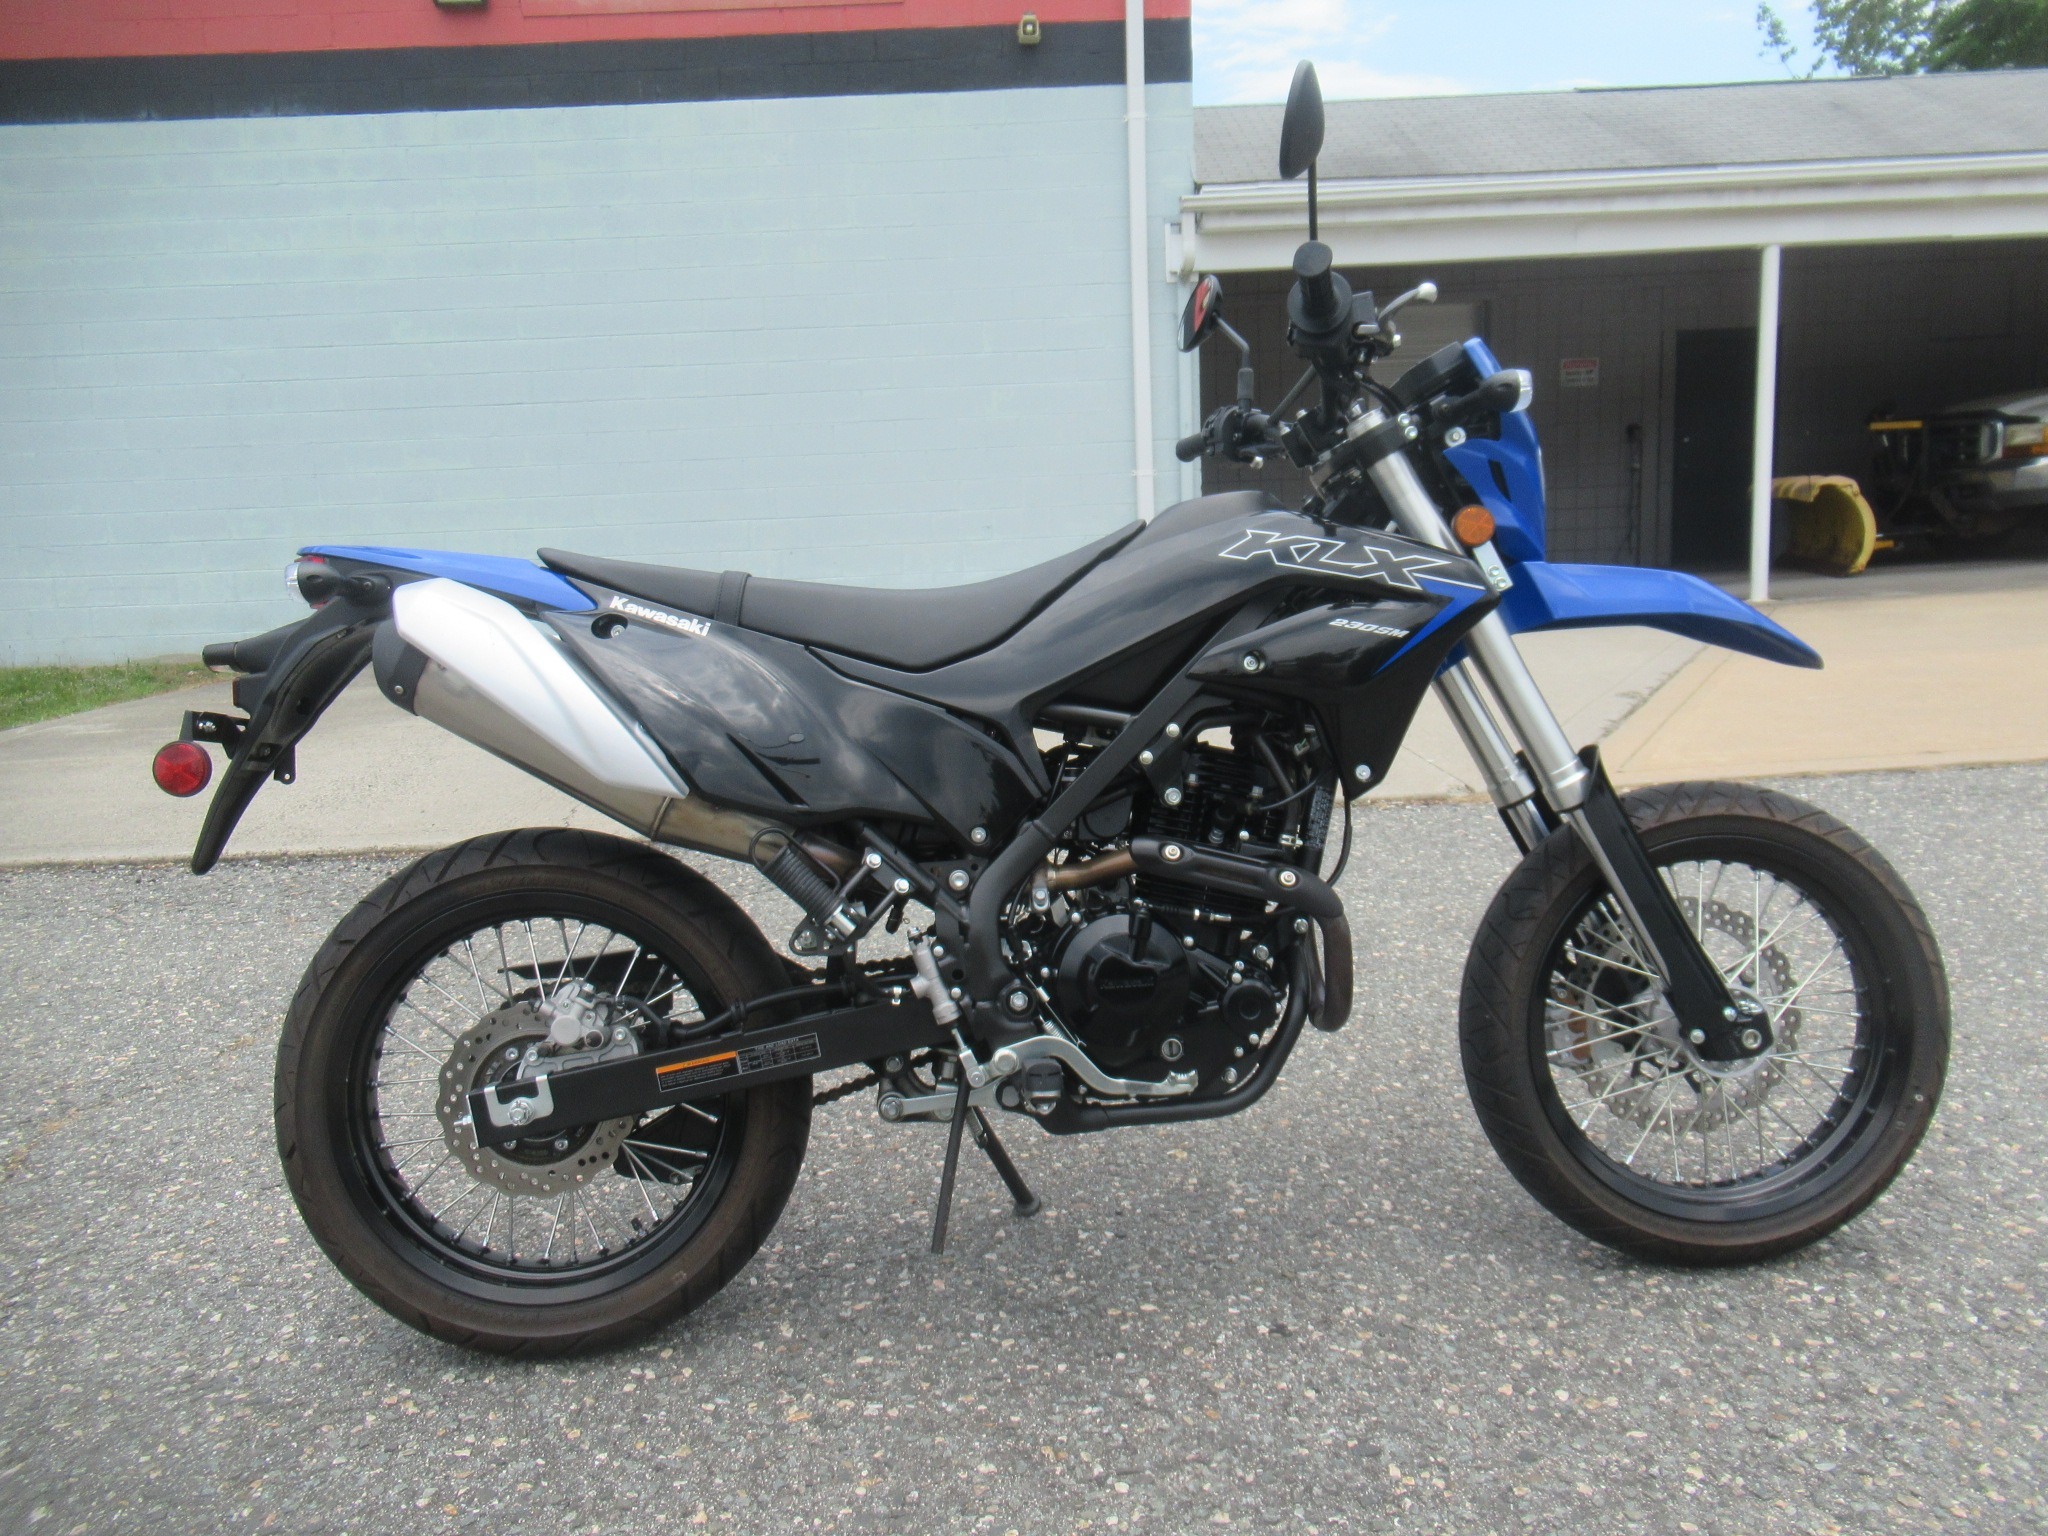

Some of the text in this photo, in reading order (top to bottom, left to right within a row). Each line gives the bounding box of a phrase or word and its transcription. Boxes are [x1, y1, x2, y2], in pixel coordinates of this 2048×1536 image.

[1219, 529, 1452, 590] KLX
[609, 596, 711, 637] Kawasaki
[1328, 618, 1410, 638] 230SM
